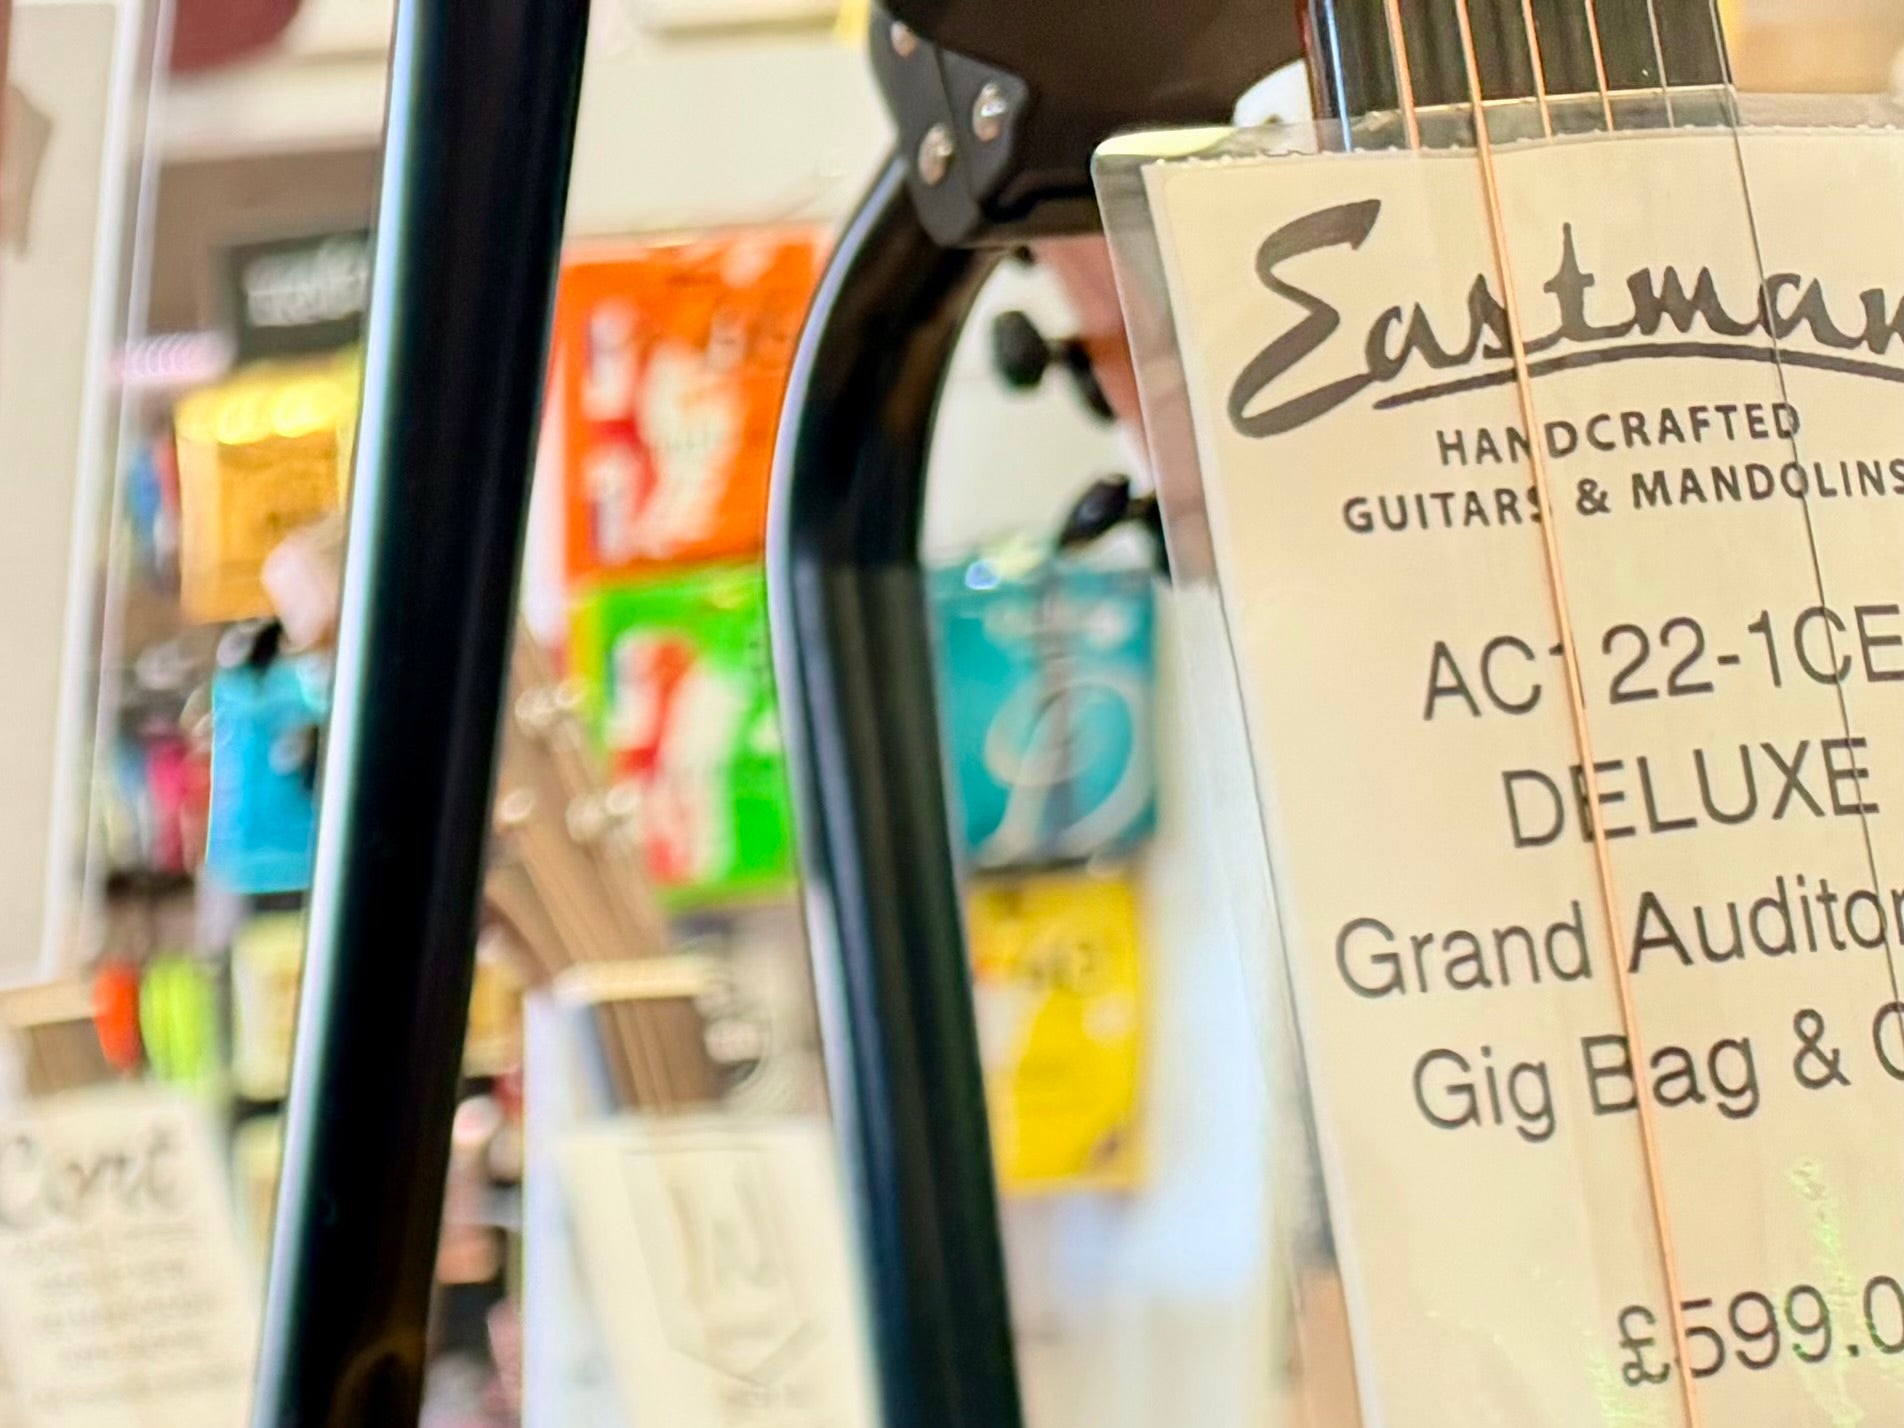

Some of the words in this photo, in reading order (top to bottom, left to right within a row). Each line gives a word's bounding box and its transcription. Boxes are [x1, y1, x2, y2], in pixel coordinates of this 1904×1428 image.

[1226, 199, 1904, 438] Eastman
[1436, 403, 1801, 466] HANDCRAFTED
[1575, 477, 1611, 516] &
[1631, 458, 1904, 509] MANDOLINS
[1423, 603, 1904, 721] AC22-1CE
[1501, 737, 1879, 849] DELUXE
[1335, 901, 1591, 999] Grand
[1410, 1044, 1557, 1144] Gig
[1581, 1032, 1760, 1120] Bag
[1793, 1007, 1851, 1090] &
